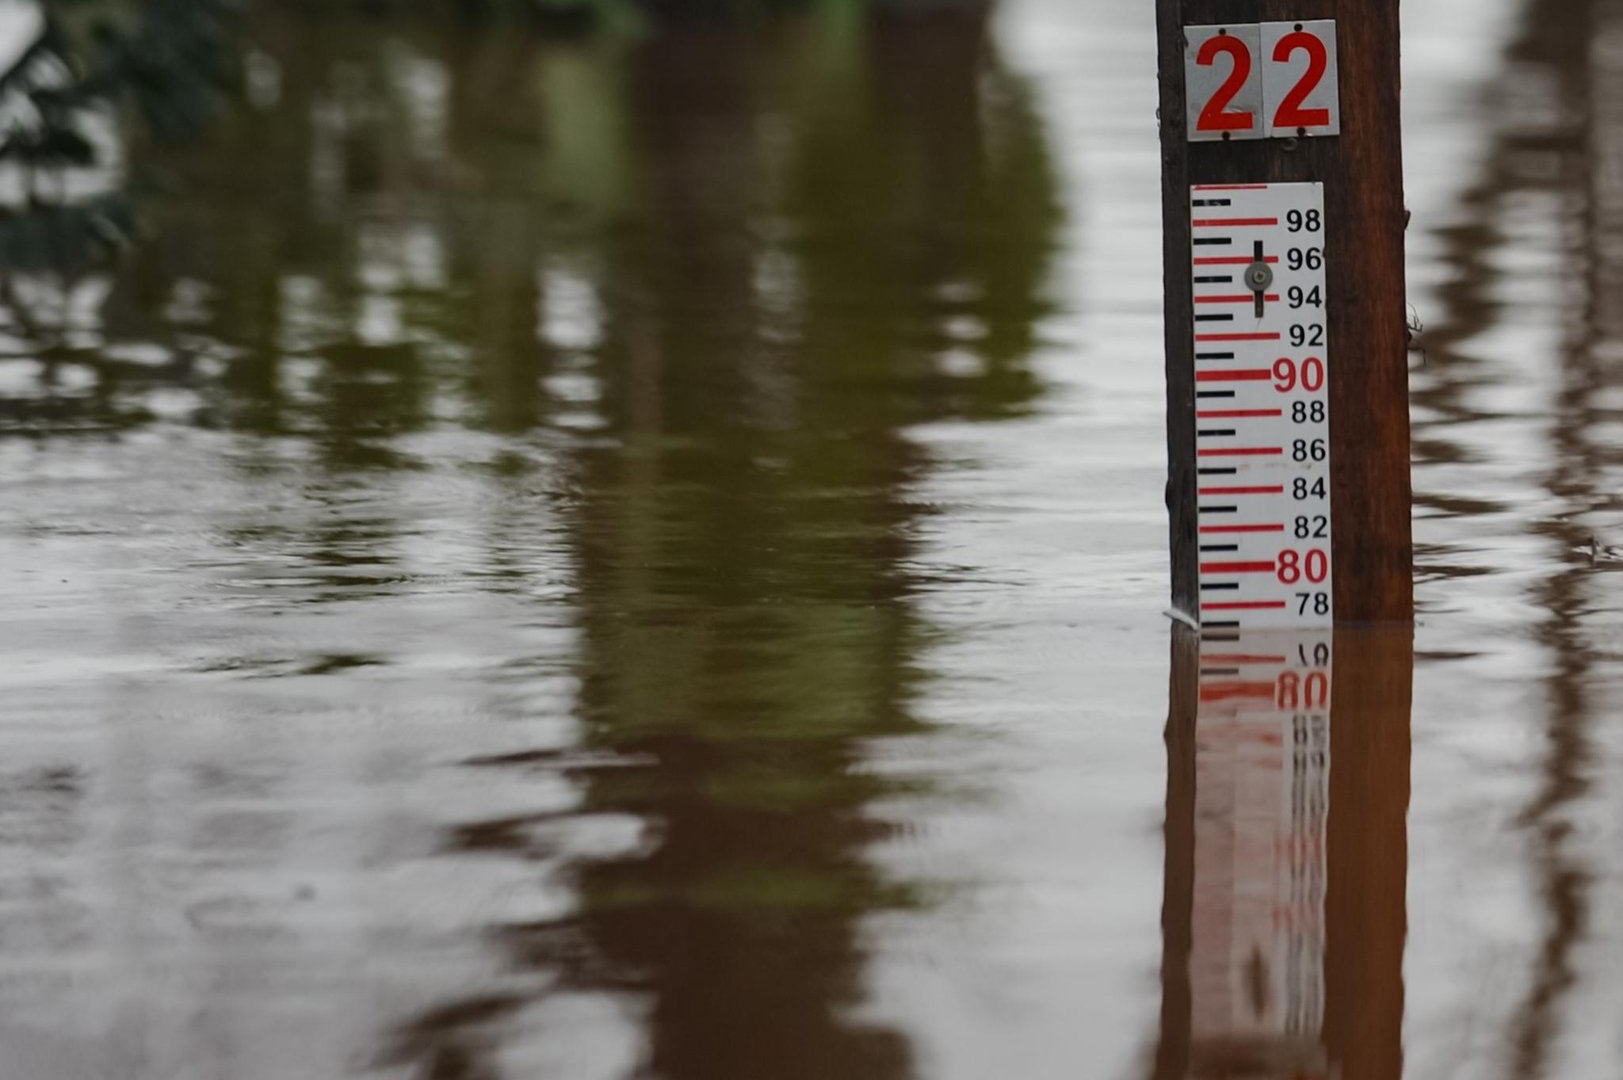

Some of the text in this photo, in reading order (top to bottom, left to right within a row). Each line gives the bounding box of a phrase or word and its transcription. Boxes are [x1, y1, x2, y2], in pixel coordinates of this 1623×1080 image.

[1196, 31, 1330, 131] 22
[1286, 209, 1321, 232] 98
[1287, 247, 1321, 270] 96
[1287, 285, 1322, 309] 94
[1289, 323, 1323, 347] 92
[1272, 357, 1324, 393] 90
[1291, 400, 1326, 424] 88
[1292, 438, 1326, 462] 86
[1292, 477, 1326, 500] 84
[1294, 515, 1328, 539] 82
[1277, 548, 1328, 584] 80
[1296, 592, 1329, 616] 78
